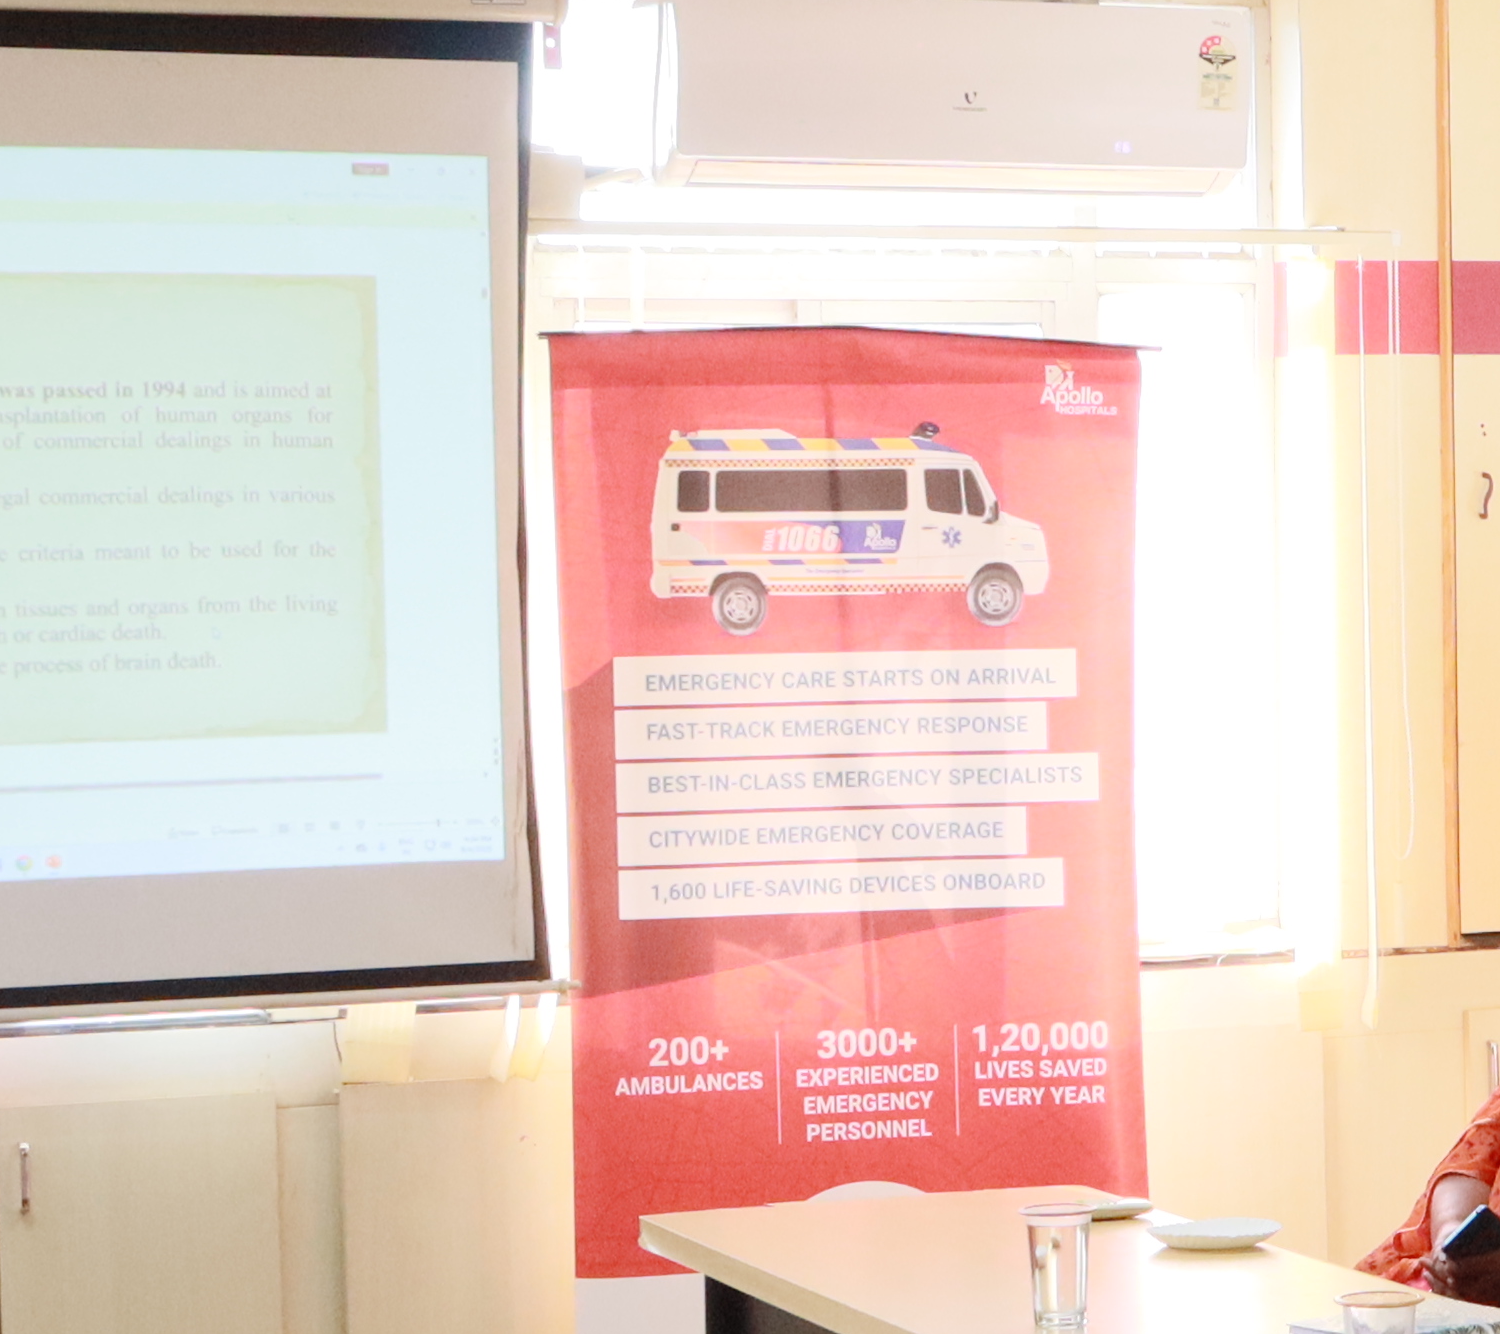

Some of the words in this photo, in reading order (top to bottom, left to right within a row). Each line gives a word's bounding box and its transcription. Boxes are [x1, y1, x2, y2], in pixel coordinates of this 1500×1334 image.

[41, 380, 108, 404] passed
[114, 380, 134, 399] in
[142, 380, 186, 399] 1994
[192, 380, 226, 399] and
[232, 380, 248, 399] is
[253, 380, 309, 399] aimed
[315, 380, 332, 399] at
[1040, 386, 1104, 412] Apollo
[120, 406, 141, 425] of
[154, 406, 217, 425] human
[231, 408, 292, 429] organs
[306, 405, 333, 424] for
[1060, 405, 1118, 416] HOSPITALS
[1, 432, 25, 451] of
[32, 431, 143, 450] commercial
[153, 431, 232, 455] dealings
[242, 431, 261, 450] in
[271, 431, 333, 450] human
[37, 487, 149, 506] commercial
[156, 486, 234, 510] dealings
[241, 486, 260, 505] in
[268, 485, 335, 504] various
[17, 543, 84, 562] criteria
[94, 542, 150, 561] meant
[160, 541, 179, 560] to
[188, 541, 211, 560] be
[219, 540, 262, 559] used
[272, 539, 298, 558] for
[308, 539, 335, 558] the
[762, 528, 776, 551] DIAL
[777, 525, 841, 552] 1066
[864, 535, 898, 549] Apollo
[14, 599, 77, 618] tissues
[85, 598, 119, 617] and
[127, 600, 189, 621] organs
[196, 595, 240, 614] from
[248, 594, 276, 613] the
[284, 593, 338, 617] living
[12, 628, 32, 644] or
[37, 624, 105, 643] cardiac
[13, 659, 83, 680] process
[89, 654, 108, 673] of
[114, 653, 161, 672] brain
[645, 672, 775, 692] EMERGENCY
[782, 670, 837, 689] CARE
[843, 669, 924, 688] STARTS
[930, 668, 960, 686] ON
[967, 667, 1057, 685] ARRIVAL
[646, 721, 776, 741] FAST-TRACK
[782, 717, 910, 738] EMERGENCY
[917, 715, 1029, 734] RESPONSE
[648, 771, 806, 794] BEST-IN-CLASS
[813, 769, 941, 789] EMERGENCY
[949, 766, 1083, 786] SPECIALISTS
[649, 828, 750, 849] CITYWIDE
[756, 824, 884, 845] EMERGENCY
[891, 821, 1004, 841] COVERAGE
[651, 882, 707, 905] 1,600
[713, 877, 843, 899] LIFE-SAVING
[850, 874, 936, 894] DEVICES
[943, 872, 1046, 891] ONBOARD
[648, 1035, 730, 1067] 200+
[816, 1027, 918, 1059] 3000+
[972, 1020, 1109, 1058] 1,20,000
[796, 1063, 940, 1088] EXPERIENCED
[974, 1059, 1034, 1079] LIVES
[1039, 1057, 1107, 1078] SAVED
[615, 1071, 764, 1096] AMBULANCES
[978, 1087, 1045, 1106] EVERY
[1050, 1085, 1106, 1104] YEAR
[803, 1090, 934, 1115] EMERGENCY
[806, 1118, 933, 1143] PERSONNEL
